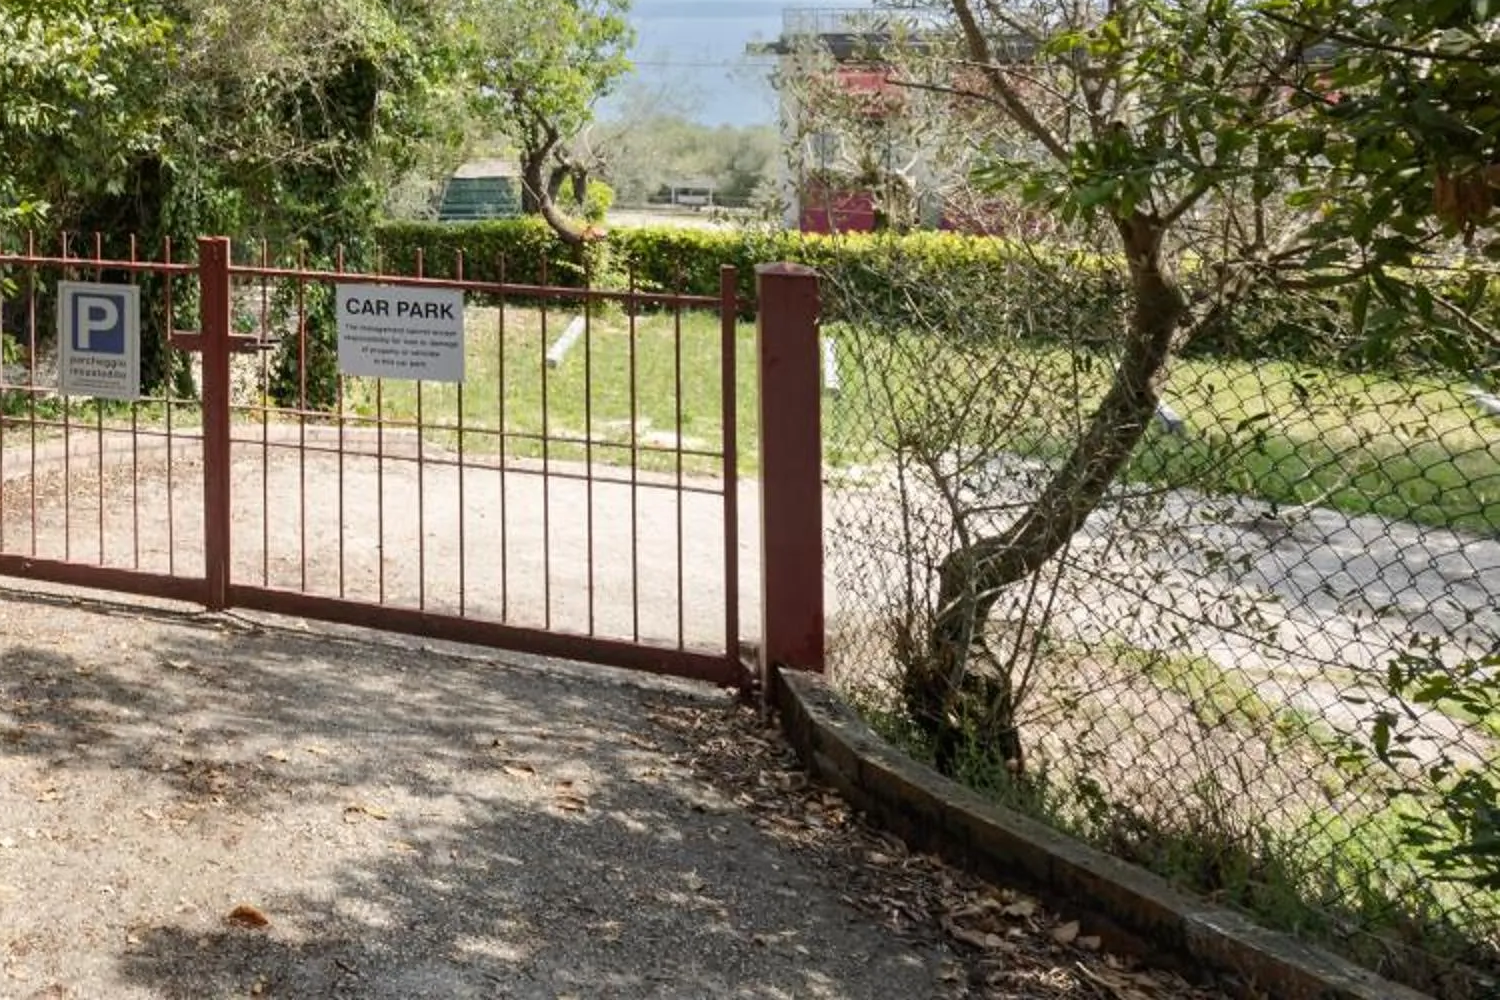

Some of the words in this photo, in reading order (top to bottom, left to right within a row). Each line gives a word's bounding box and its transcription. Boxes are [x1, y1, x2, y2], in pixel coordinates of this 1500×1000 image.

[77, 296, 118, 349] P
[345, 297, 389, 317] CAR
[397, 301, 454, 320] PARK
